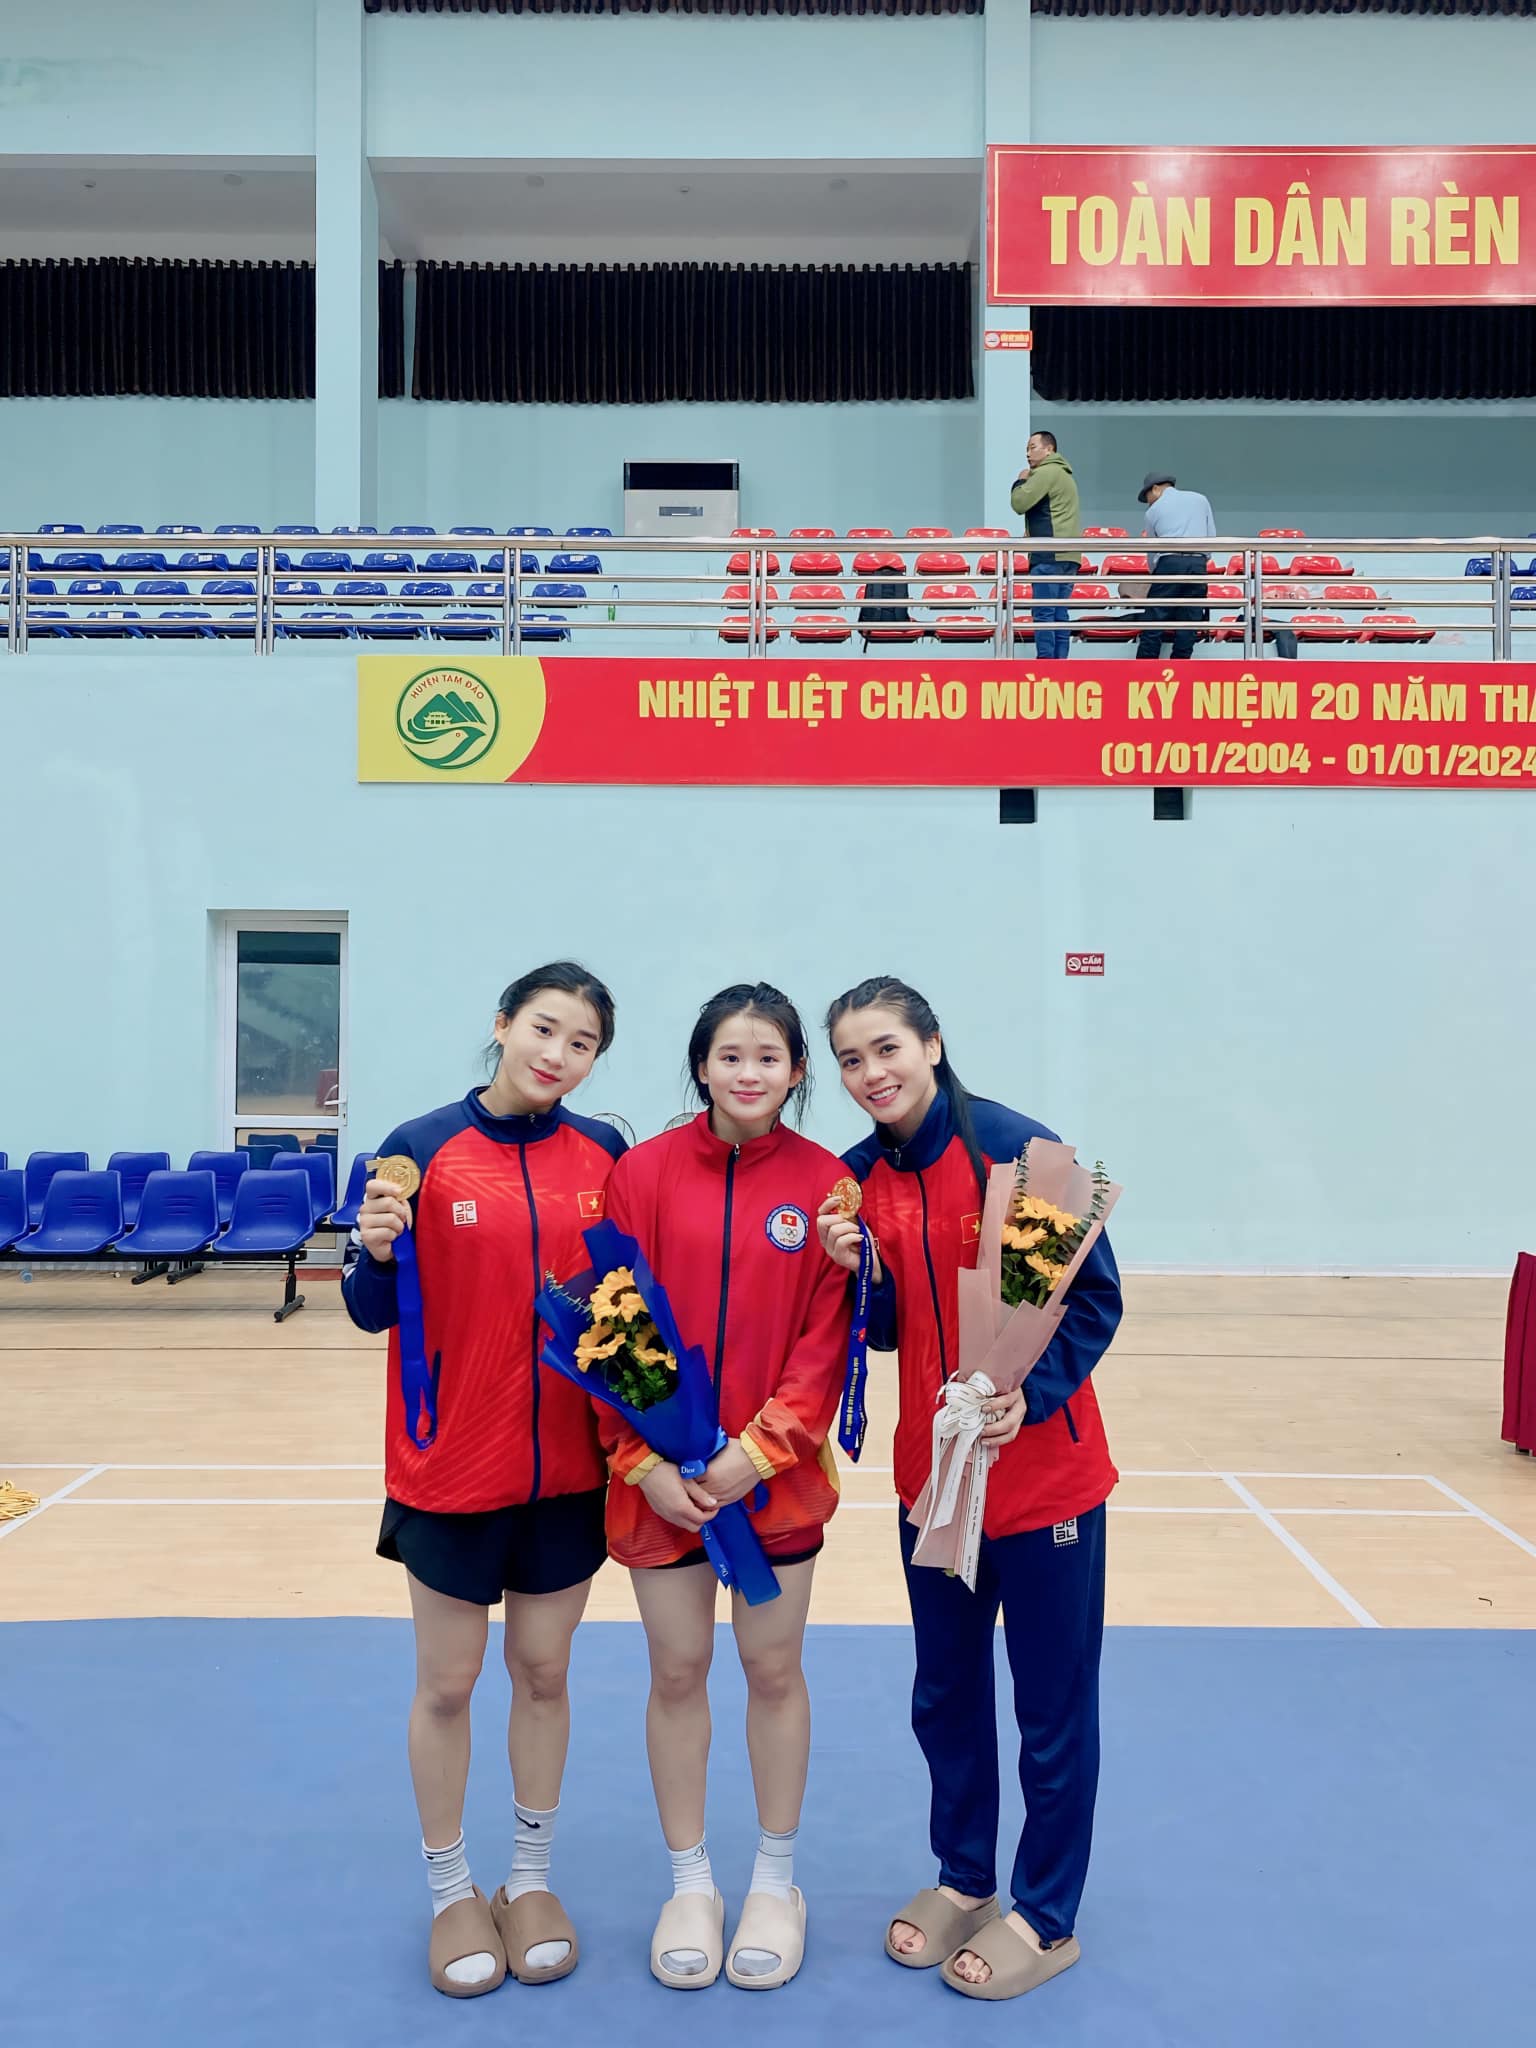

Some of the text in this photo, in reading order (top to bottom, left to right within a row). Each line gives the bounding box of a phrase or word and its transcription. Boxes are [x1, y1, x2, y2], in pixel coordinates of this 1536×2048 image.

[1042, 181, 1520, 266] TOÀN DÂN RÈN
[441, 674, 463, 685] TAM
[638, 673, 755, 727] NHIỆT
[767, 673, 848, 727] LIỆT
[860, 673, 967, 720] CHÀO
[981, 673, 1102, 720] MỪNG
[1128, 669, 1180, 719] KỶ
[1192, 674, 1298, 728] NIỆM
[1310, 682, 1360, 721] 20
[1373, 676, 1467, 722] NĂM
[1101, 742, 1536, 777] (01/01/2004 - 01/01/2024
